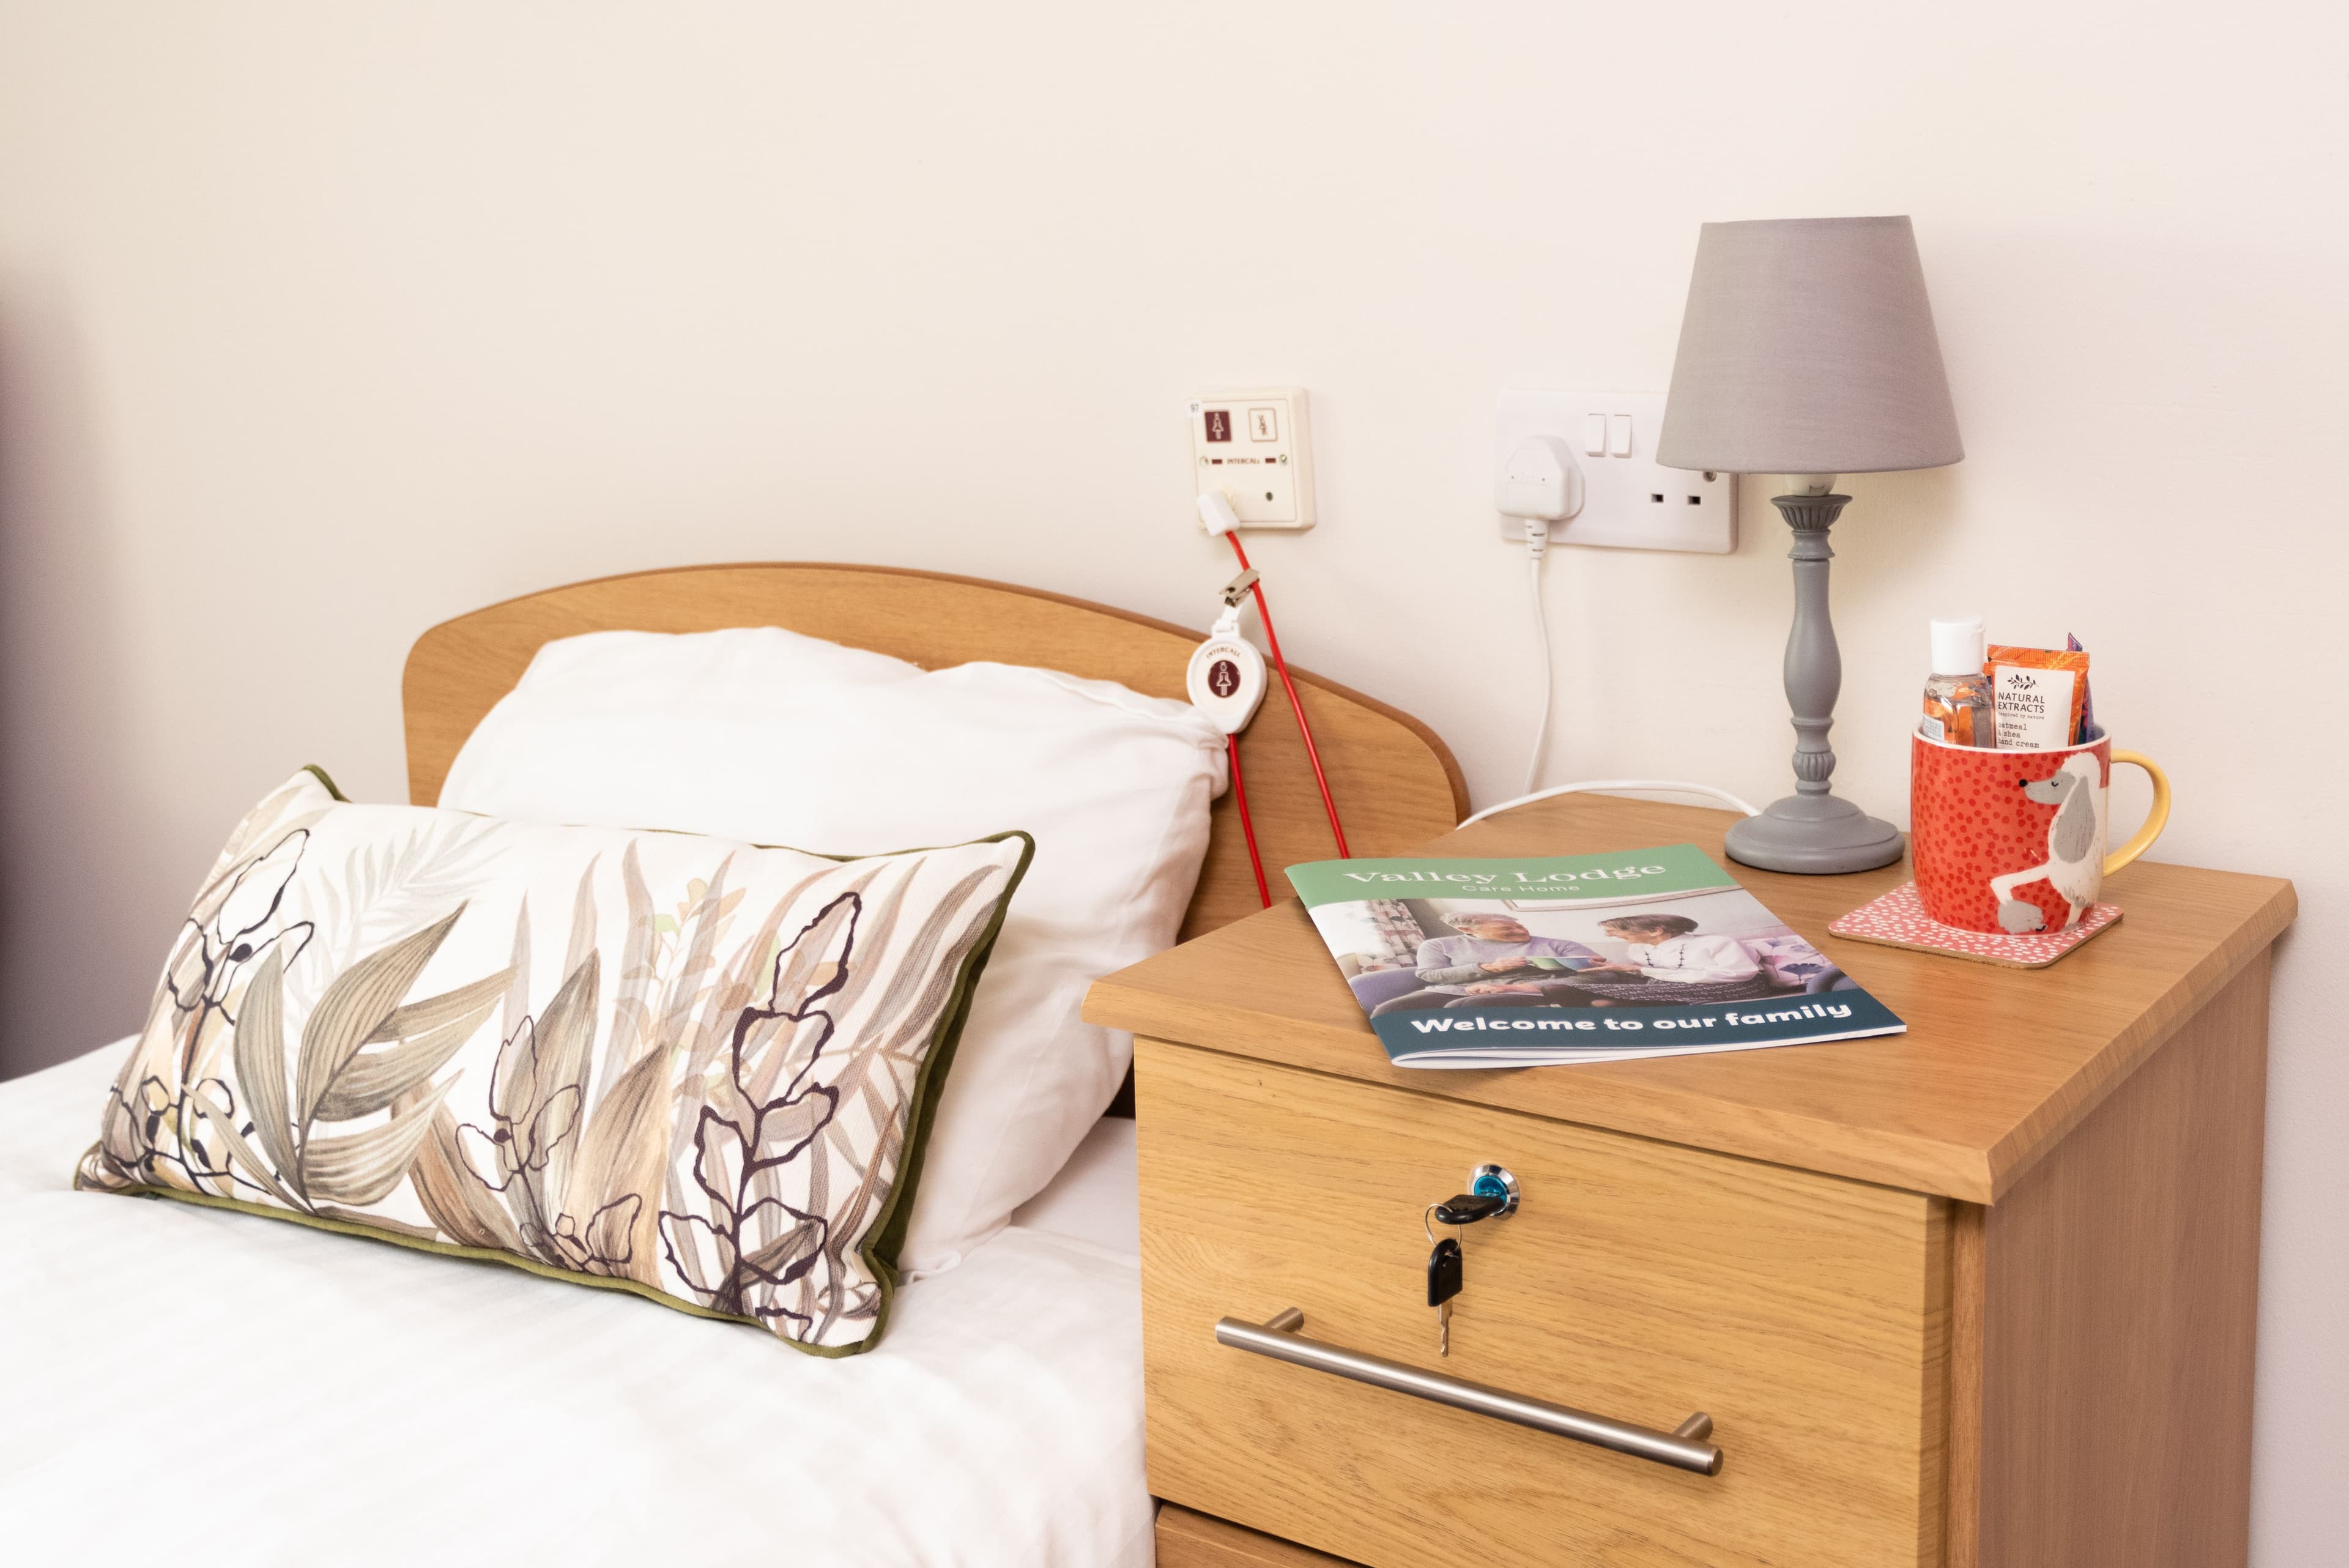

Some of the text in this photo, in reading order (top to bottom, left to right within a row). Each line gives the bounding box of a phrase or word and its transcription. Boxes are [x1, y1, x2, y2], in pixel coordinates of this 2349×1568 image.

[1206, 647, 1241, 659] INTERCALL
[1998, 692, 2045, 704] NATURAL
[1998, 702, 2044, 713] EXTRACTS
[1998, 737, 2013, 746] hand
[1342, 865, 1666, 885] Valley Lodge
[1410, 1003, 1852, 1034] Welcome to our family
